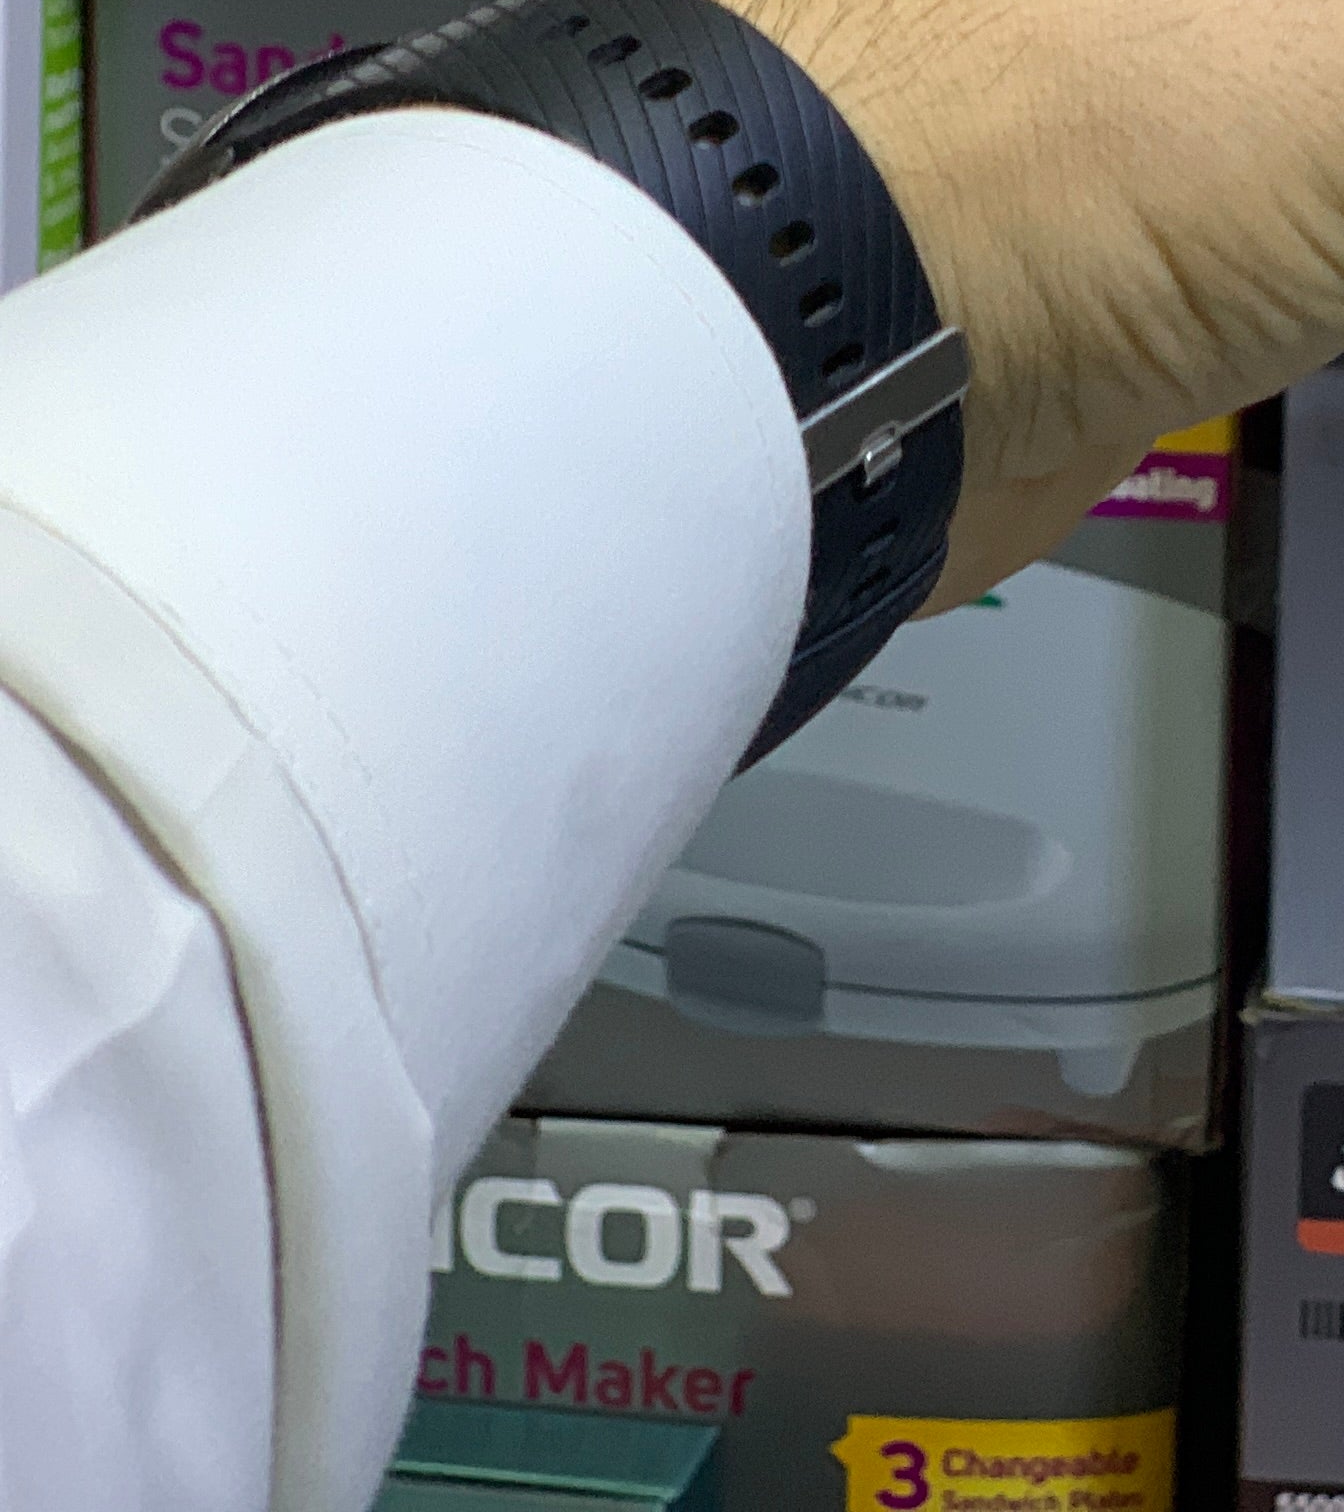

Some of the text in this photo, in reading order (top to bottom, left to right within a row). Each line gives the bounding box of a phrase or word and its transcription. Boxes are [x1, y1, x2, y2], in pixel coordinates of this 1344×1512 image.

[158, 19, 347, 96] San
[416, 1333, 756, 1416] ch Maker
[874, 1439, 1141, 1510] 3 Changeable
